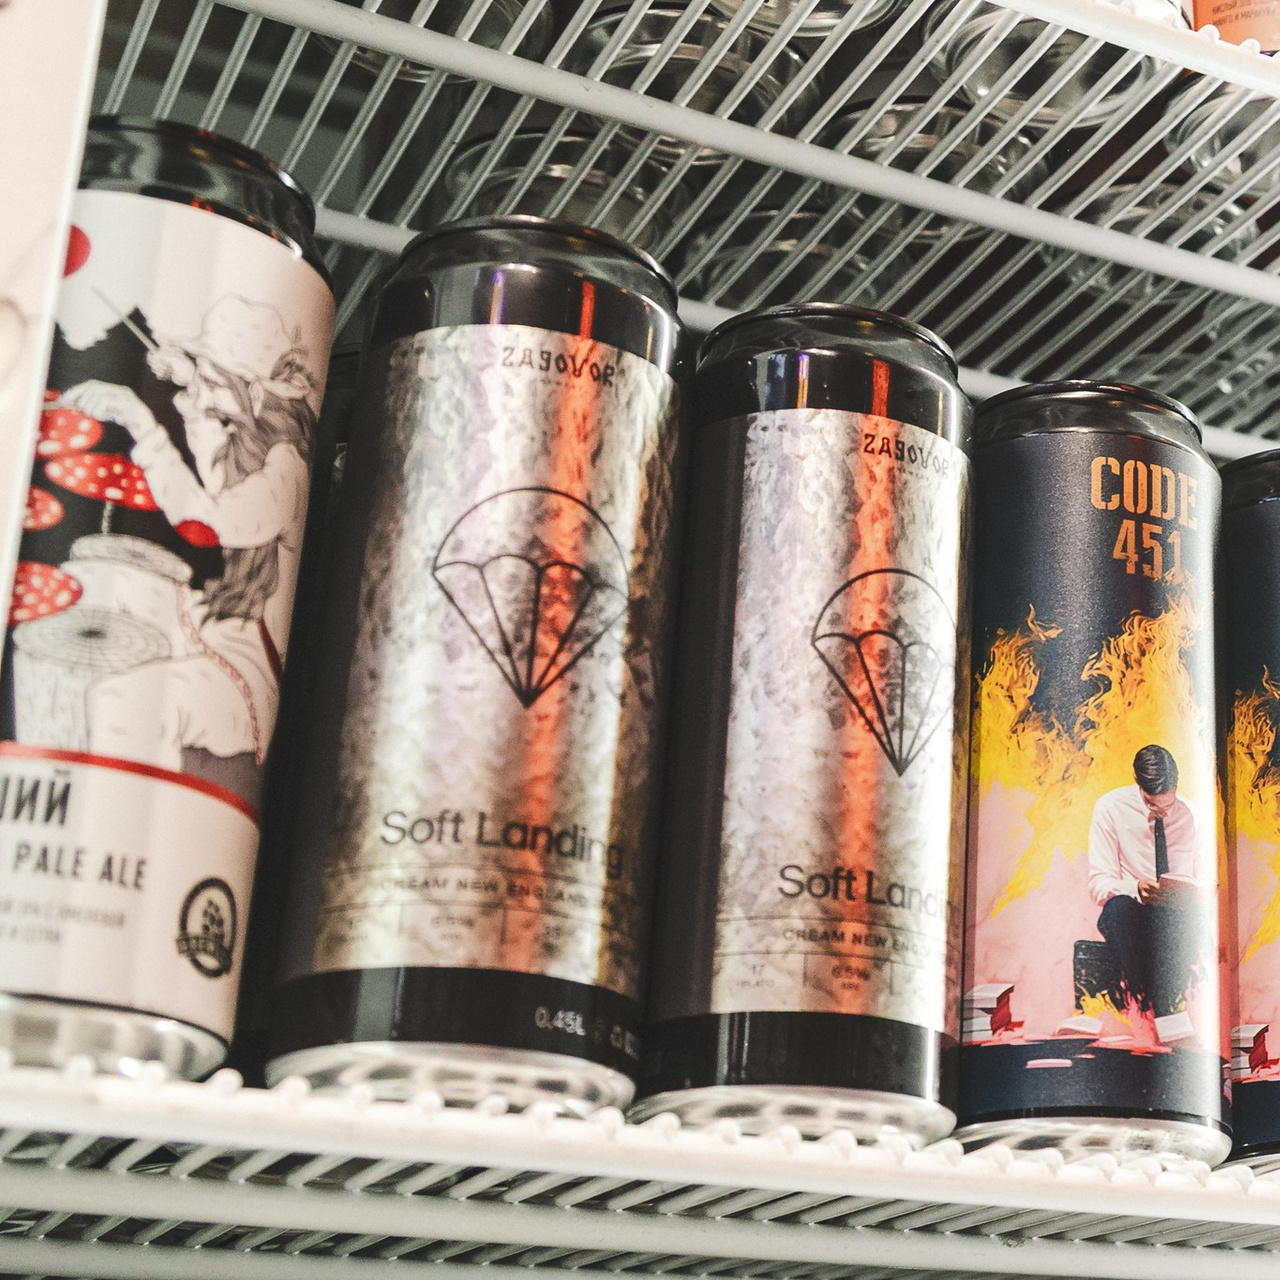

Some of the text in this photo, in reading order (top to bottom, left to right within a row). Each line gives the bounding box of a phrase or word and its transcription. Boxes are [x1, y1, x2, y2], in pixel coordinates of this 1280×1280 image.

[1090, 456, 1198, 531] CODE
[1112, 519, 1184, 580] 451
[13, 841, 148, 890] PALE ALE
[381, 810, 623, 880] Soft Landing
[456, 878, 498, 893] NEW
[778, 864, 857, 901] Soft
[783, 928, 888, 947] CREAM NEW
